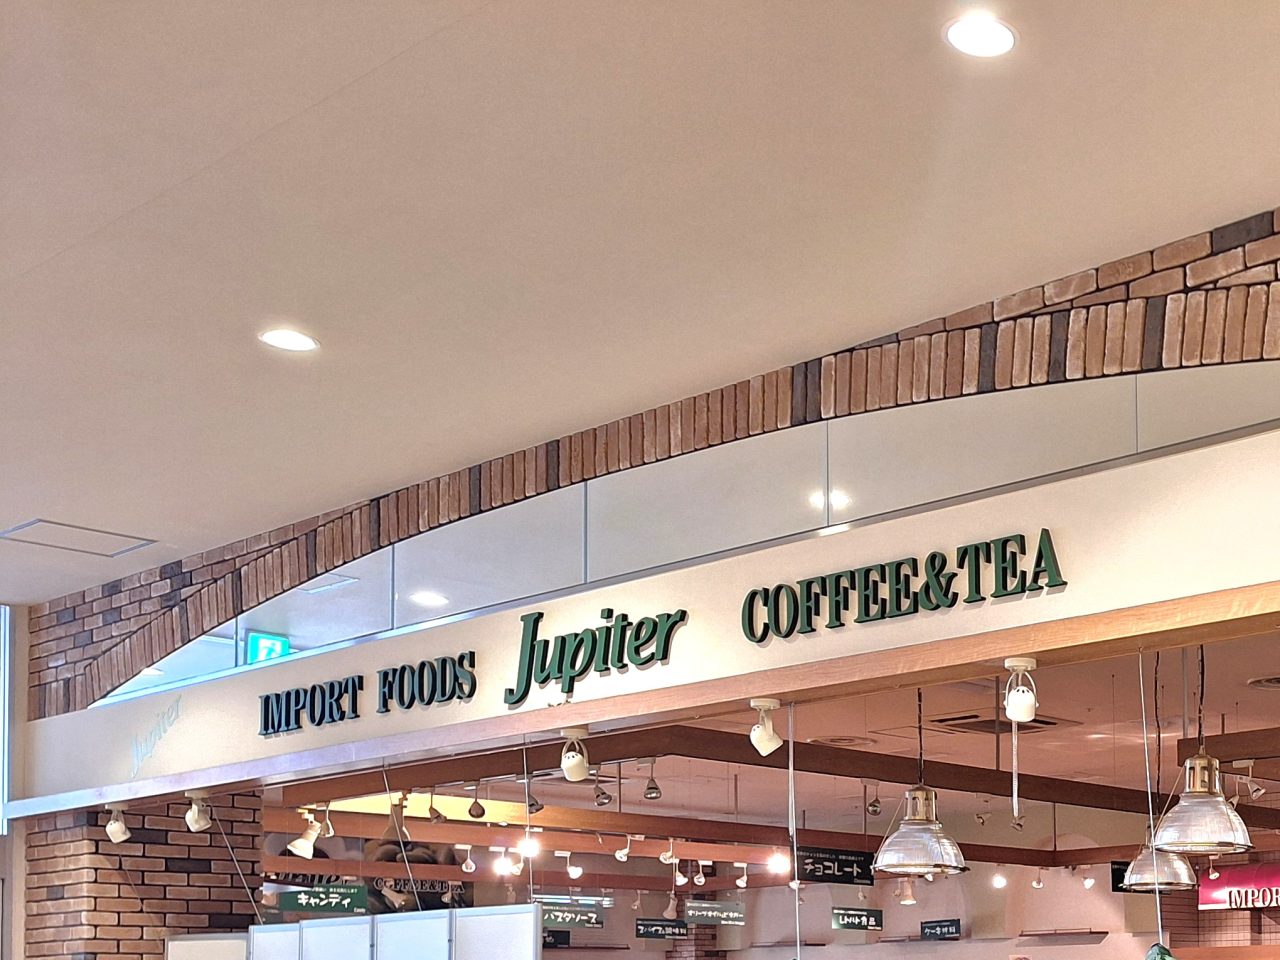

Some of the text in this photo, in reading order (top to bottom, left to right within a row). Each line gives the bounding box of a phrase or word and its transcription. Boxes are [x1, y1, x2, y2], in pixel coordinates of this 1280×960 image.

[741, 527, 1068, 644] COFFEE&TEA
[258, 650, 478, 737] IMPORT FOODS
[503, 607, 688, 706] Jupiter
[297, 892, 352, 909] キャンディ
[803, 858, 862, 877] チョコレート
